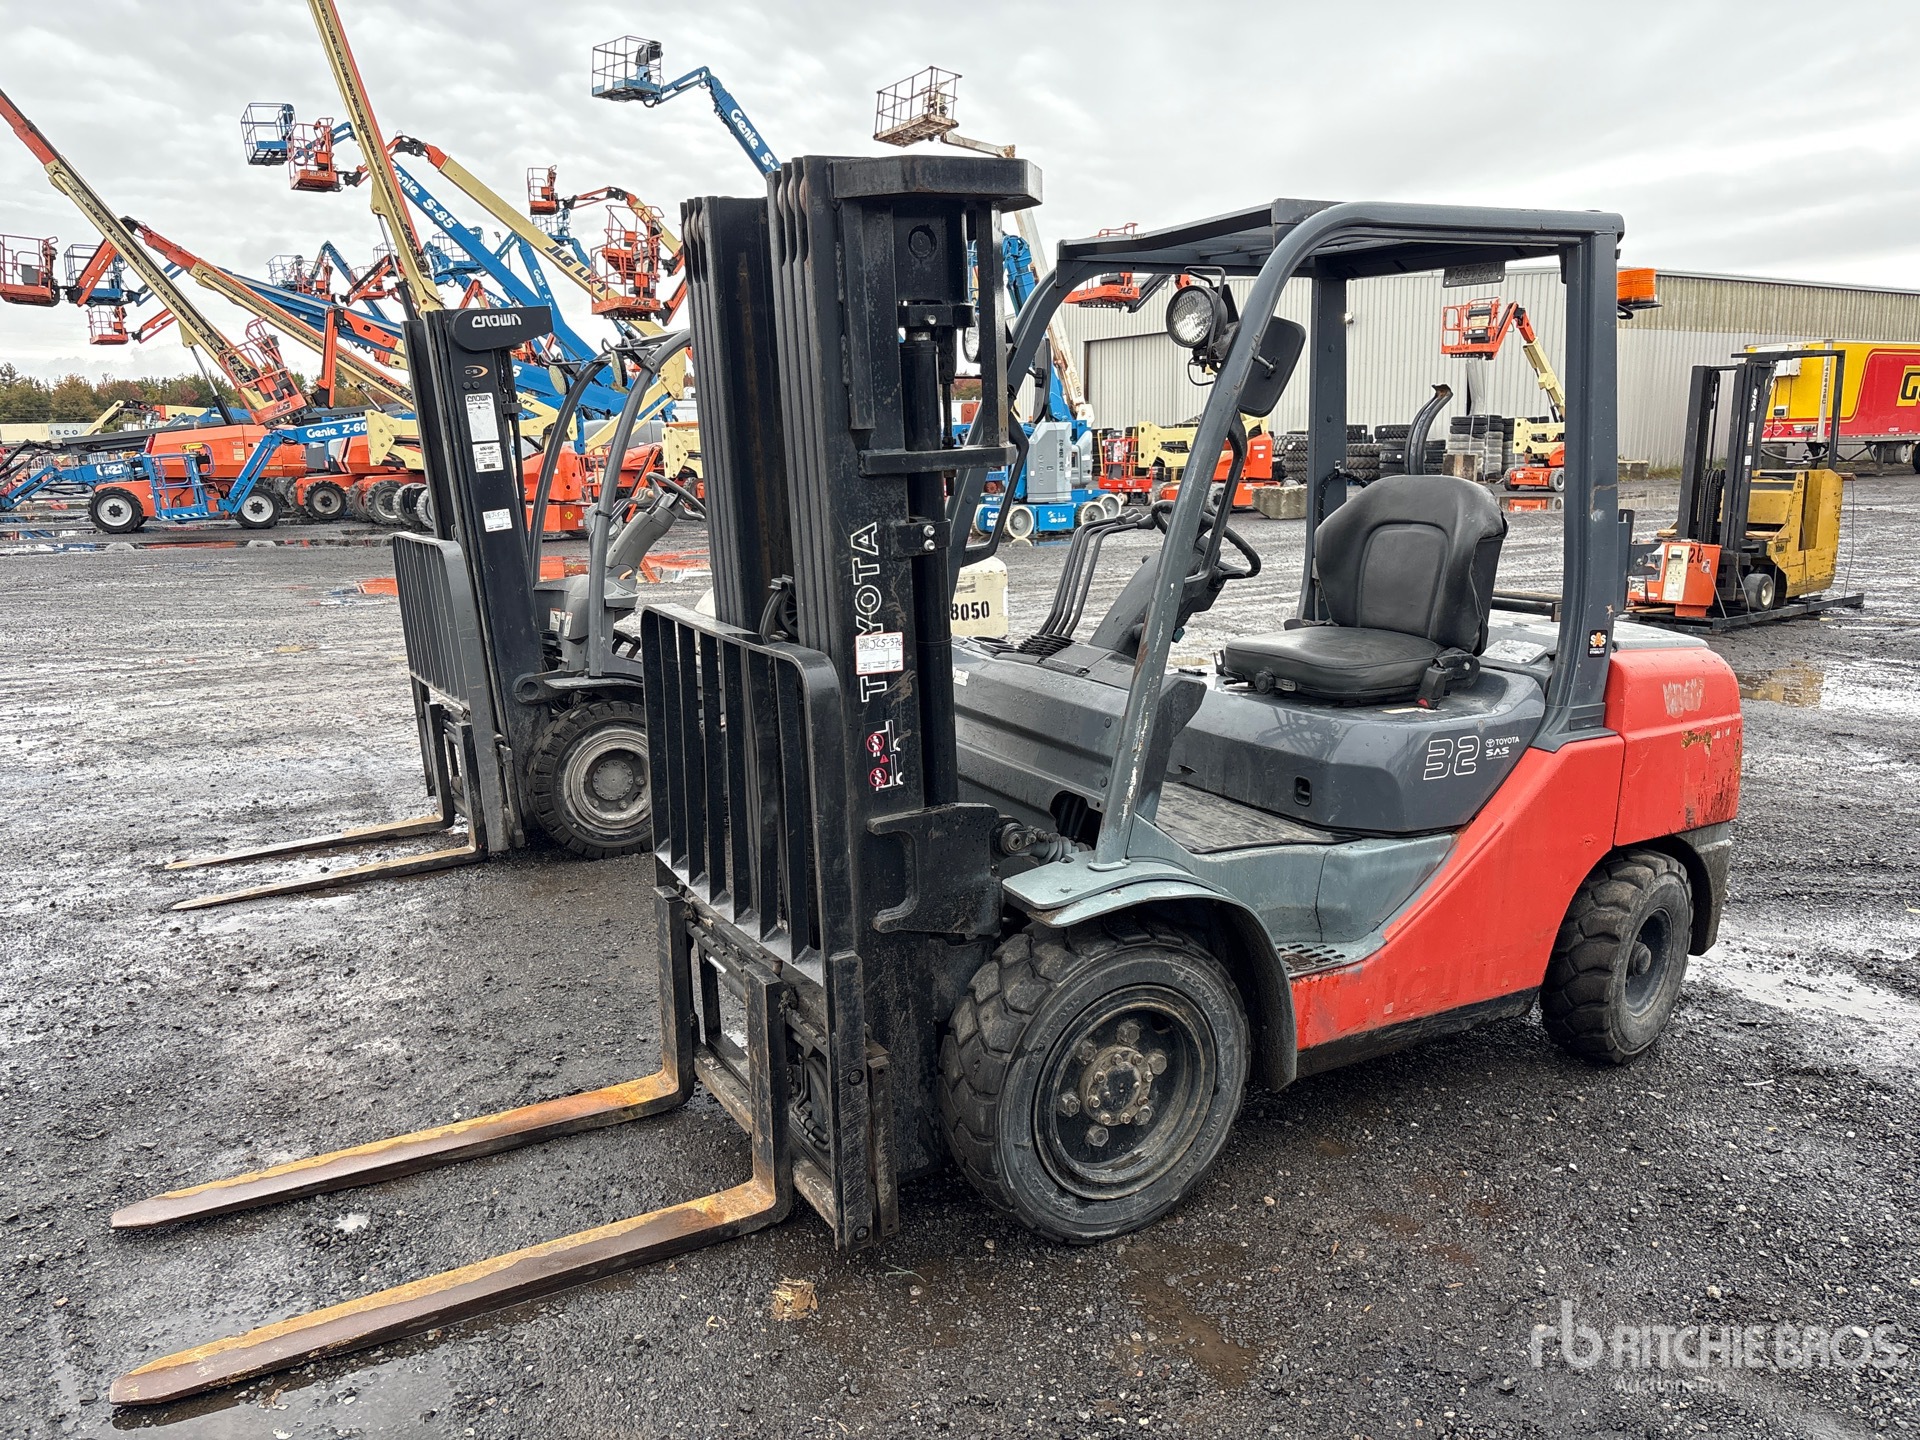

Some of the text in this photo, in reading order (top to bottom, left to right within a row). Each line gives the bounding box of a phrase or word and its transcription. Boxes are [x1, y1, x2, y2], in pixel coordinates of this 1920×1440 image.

[731, 109, 781, 171] Genie S-
[391, 161, 457, 229] enie S-85
[544, 245, 577, 268] JLG
[471, 313, 522, 328] CROWN
[306, 422, 368, 438] Genie Z-60
[850, 521, 888, 703] TYOTA
[1590, 632, 1607, 647] SAS
[1495, 736, 1520, 746] TOYOTA
[1423, 735, 1480, 781] 32
[1485, 746, 1510, 757] SAS
